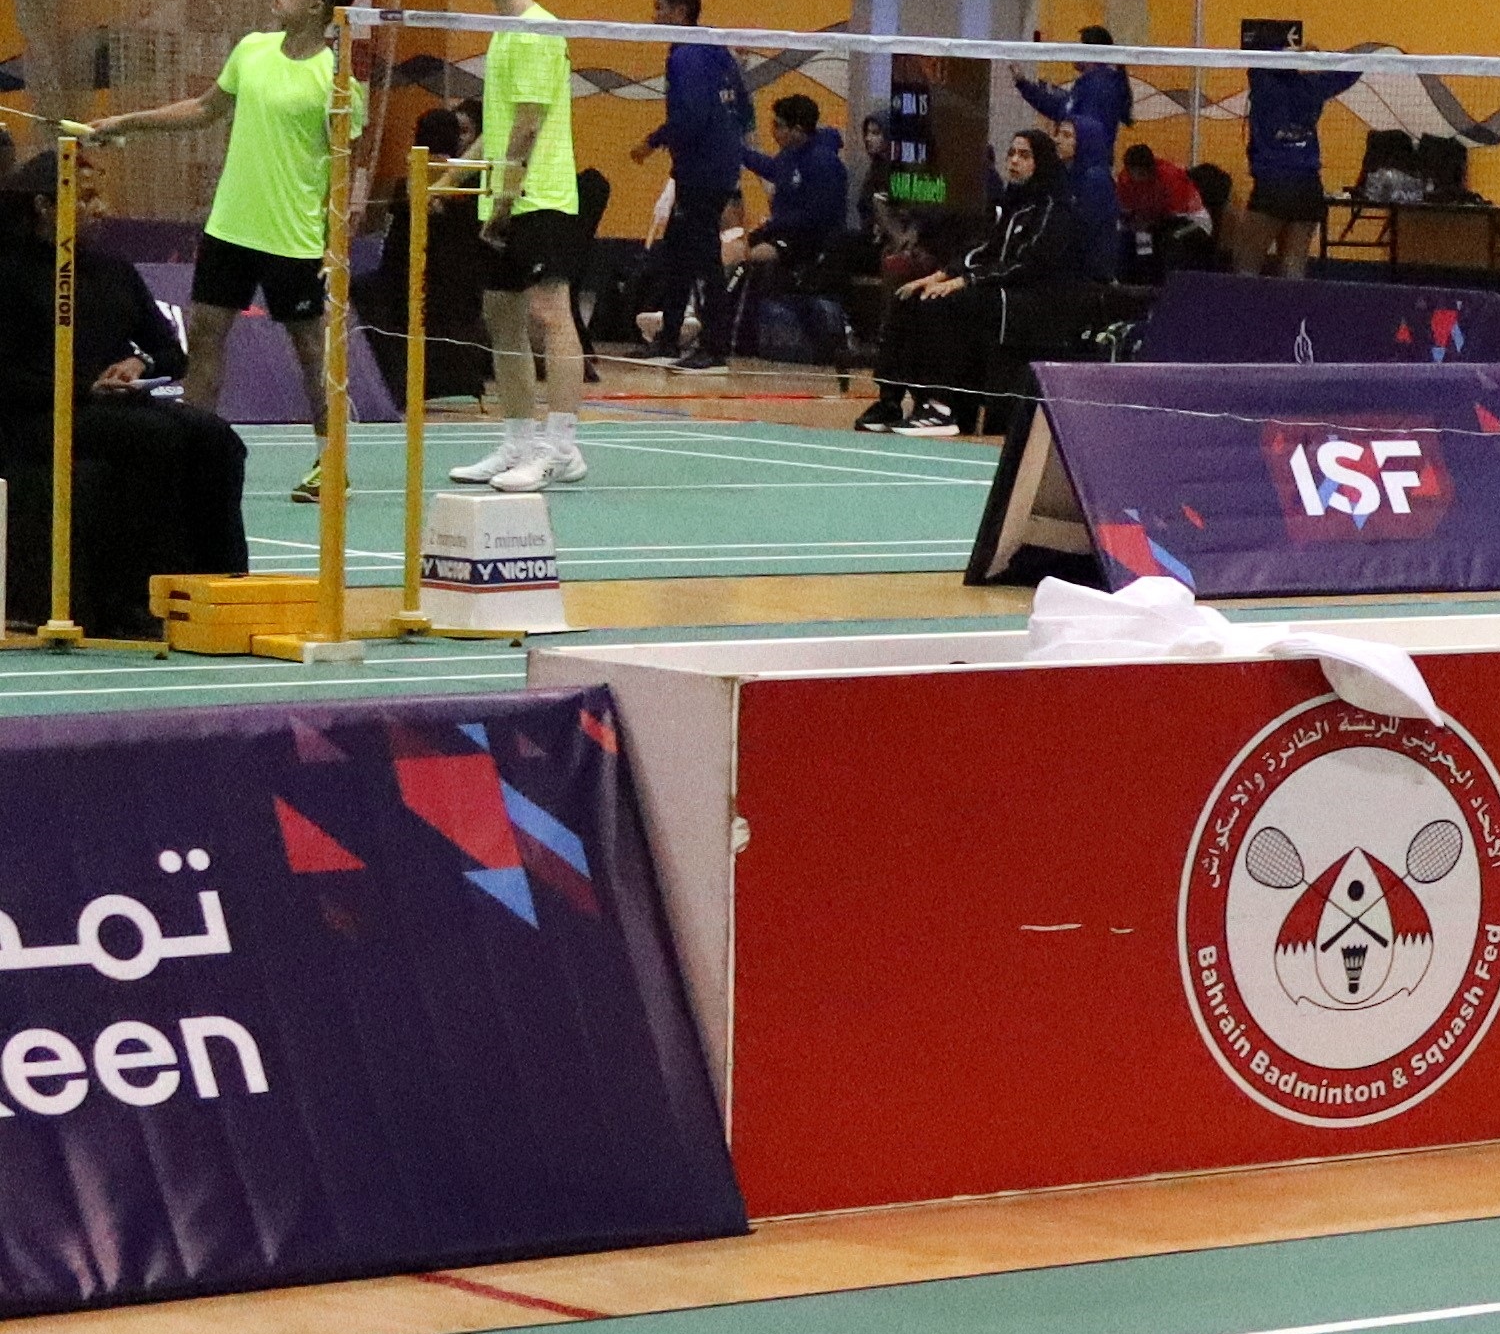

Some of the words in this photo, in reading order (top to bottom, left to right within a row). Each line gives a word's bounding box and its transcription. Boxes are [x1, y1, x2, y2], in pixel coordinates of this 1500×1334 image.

[59, 261, 72, 328] VICTOR
[1289, 438, 1422, 518] ISF
[483, 532, 491, 550] 2
[494, 532, 545, 550] minutes
[1197, 944, 1252, 1060] Bahrain
[1249, 1049, 1388, 1106] Badminton
[1391, 1065, 1411, 1091] &
[1411, 984, 1486, 1080] Squash
